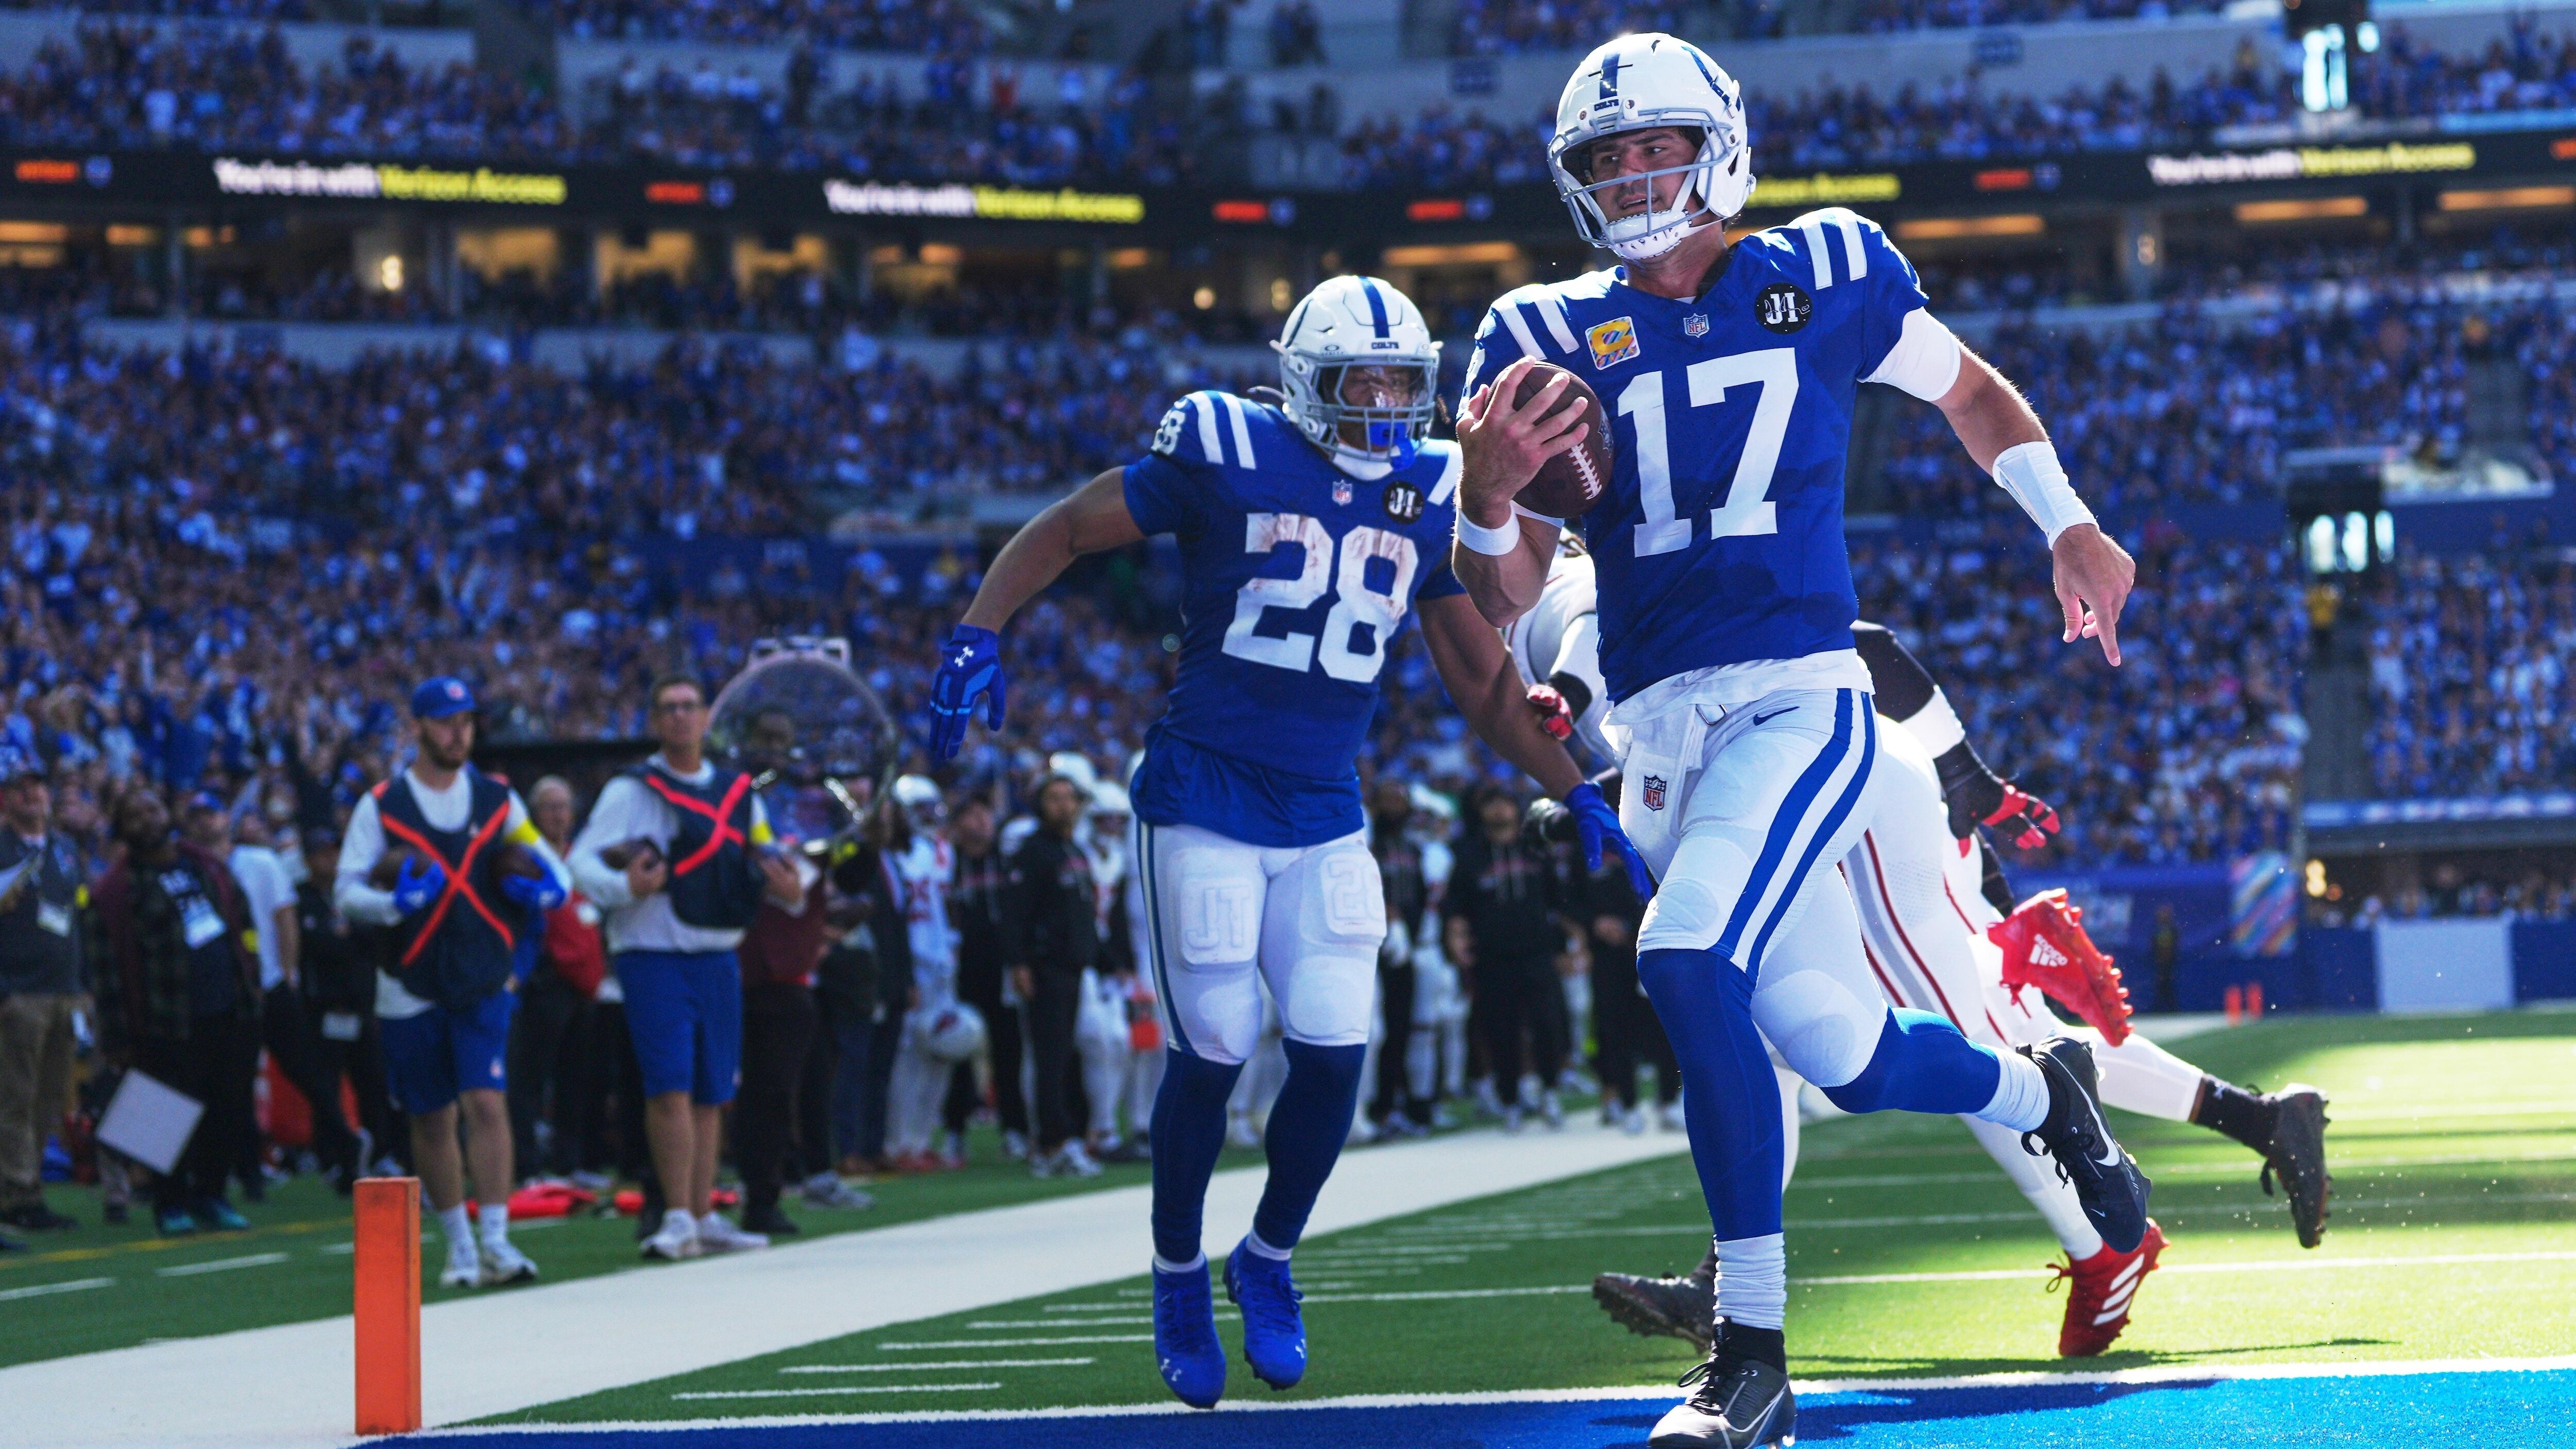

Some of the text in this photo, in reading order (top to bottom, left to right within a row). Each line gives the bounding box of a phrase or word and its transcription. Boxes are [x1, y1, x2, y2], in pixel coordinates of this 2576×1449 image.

[1594, 99, 1619, 111] COLTS
[1591, 321, 1633, 356] C
[1688, 323, 1705, 332] NFL
[1371, 341, 1399, 349] COLTS
[1618, 347, 1799, 557] 17
[1222, 513, 1418, 683] 28
[1645, 788, 1663, 807] NFL
[1186, 886, 1252, 948] JT
